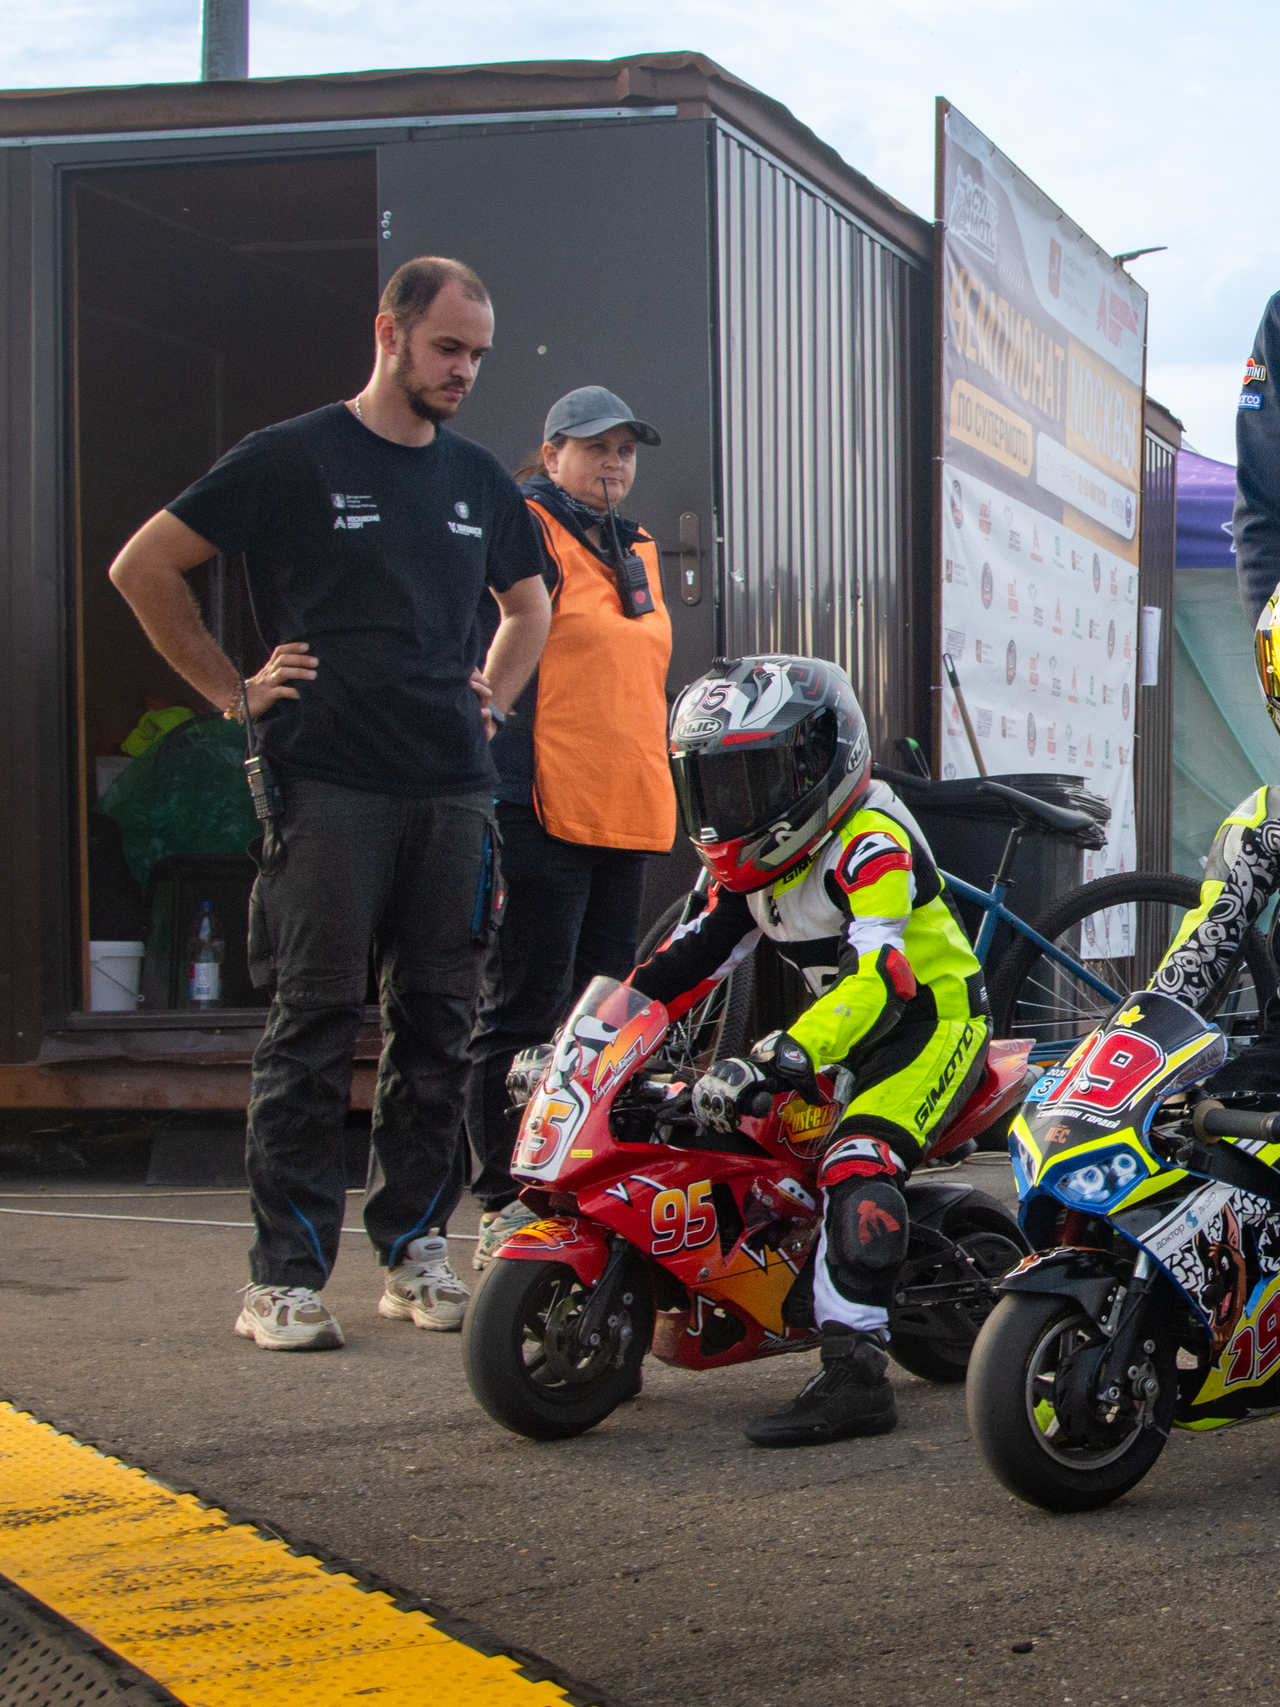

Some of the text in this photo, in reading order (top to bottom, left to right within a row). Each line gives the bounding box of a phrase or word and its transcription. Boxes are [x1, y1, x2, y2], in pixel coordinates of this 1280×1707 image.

[951, 262, 1137, 473] ЧЕМПИОНАТ МОСКВЫ
[957, 391, 1028, 466] ПО СУПЕРМОТО
[682, 719, 717, 735] HJC
[683, 681, 737, 721] 95
[914, 1022, 976, 1131] GIMOTO
[1036, 1078, 1056, 1096] 3
[1037, 1029, 1168, 1116] 19
[1081, 1113, 1122, 1130] ГОРДЕЙ
[652, 1179, 718, 1255] 95
[1155, 1223, 1186, 1252] ДОКТОР
